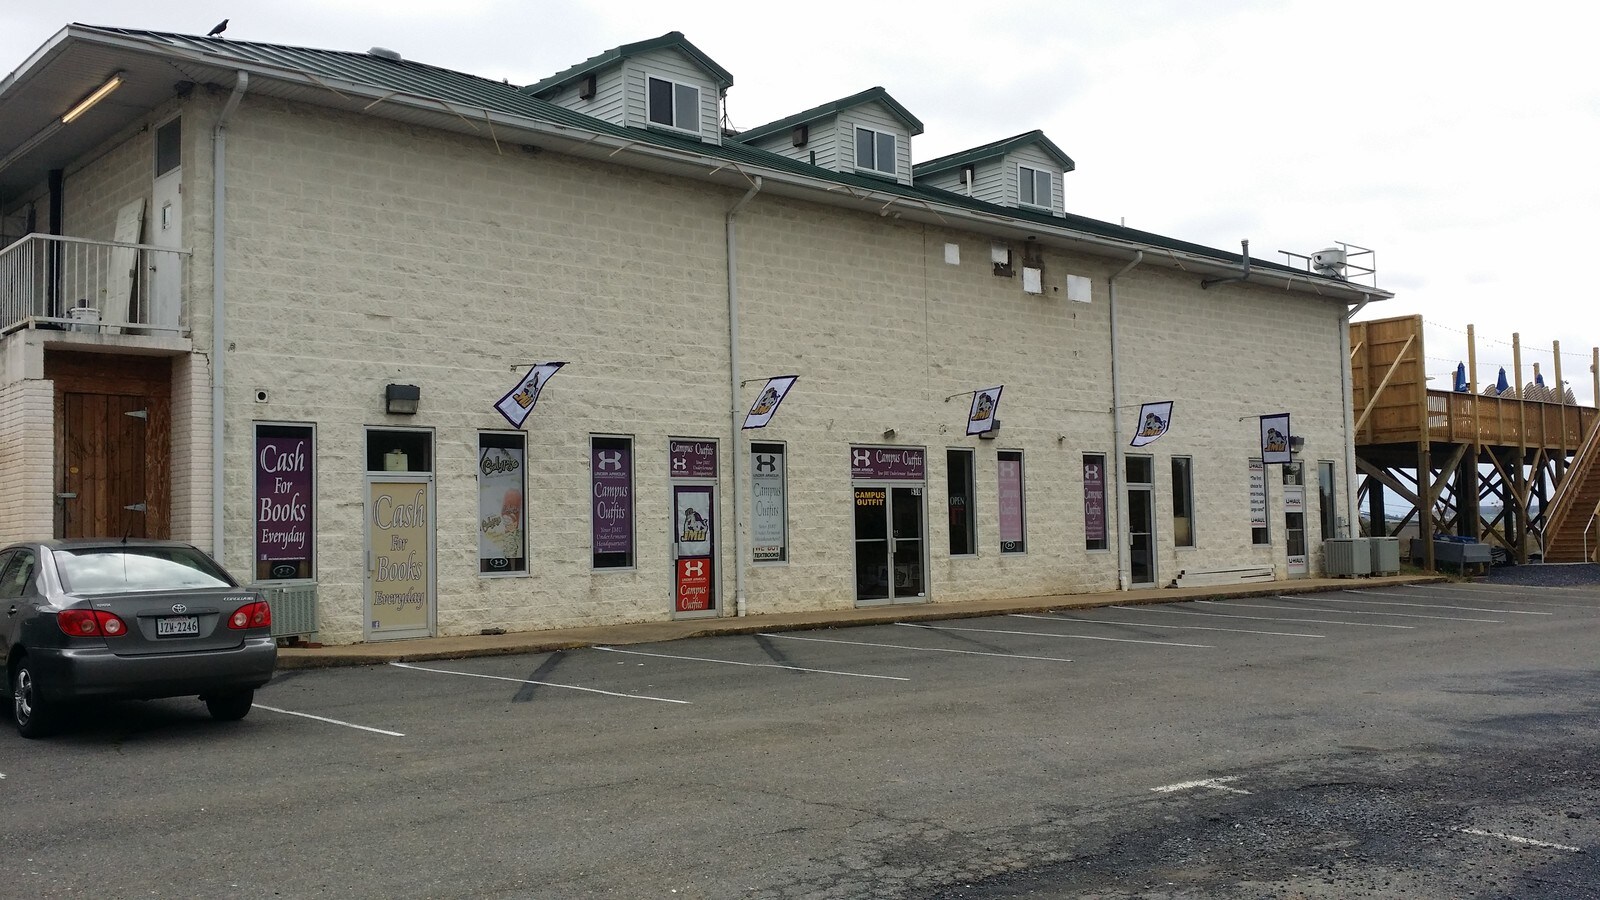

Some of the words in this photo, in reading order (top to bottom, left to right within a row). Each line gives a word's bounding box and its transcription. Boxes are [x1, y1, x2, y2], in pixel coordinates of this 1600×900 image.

[260, 440, 305, 474] Cash
[671, 441, 694, 458] Campus
[695, 442, 714, 460] Outfits
[876, 449, 901, 469] Campus
[902, 450, 923, 472] Outfits
[273, 476, 293, 495] For
[594, 482, 628, 504] Campus
[753, 482, 781, 499] Campus
[854, 491, 886, 499] CAMPUS
[259, 492, 307, 523] Books
[372, 488, 425, 530] Cash
[756, 500, 779, 523] Outfits
[856, 498, 884, 506] OUTFIT
[949, 496, 965, 506] OPEN
[596, 500, 626, 526] Outfits
[261, 525, 306, 550] Everyday
[390, 534, 408, 552] For
[376, 550, 423, 582] Books
[373, 585, 425, 611] Everyday
[680, 584, 706, 599] Campus
[681, 596, 703, 611] Outfits
